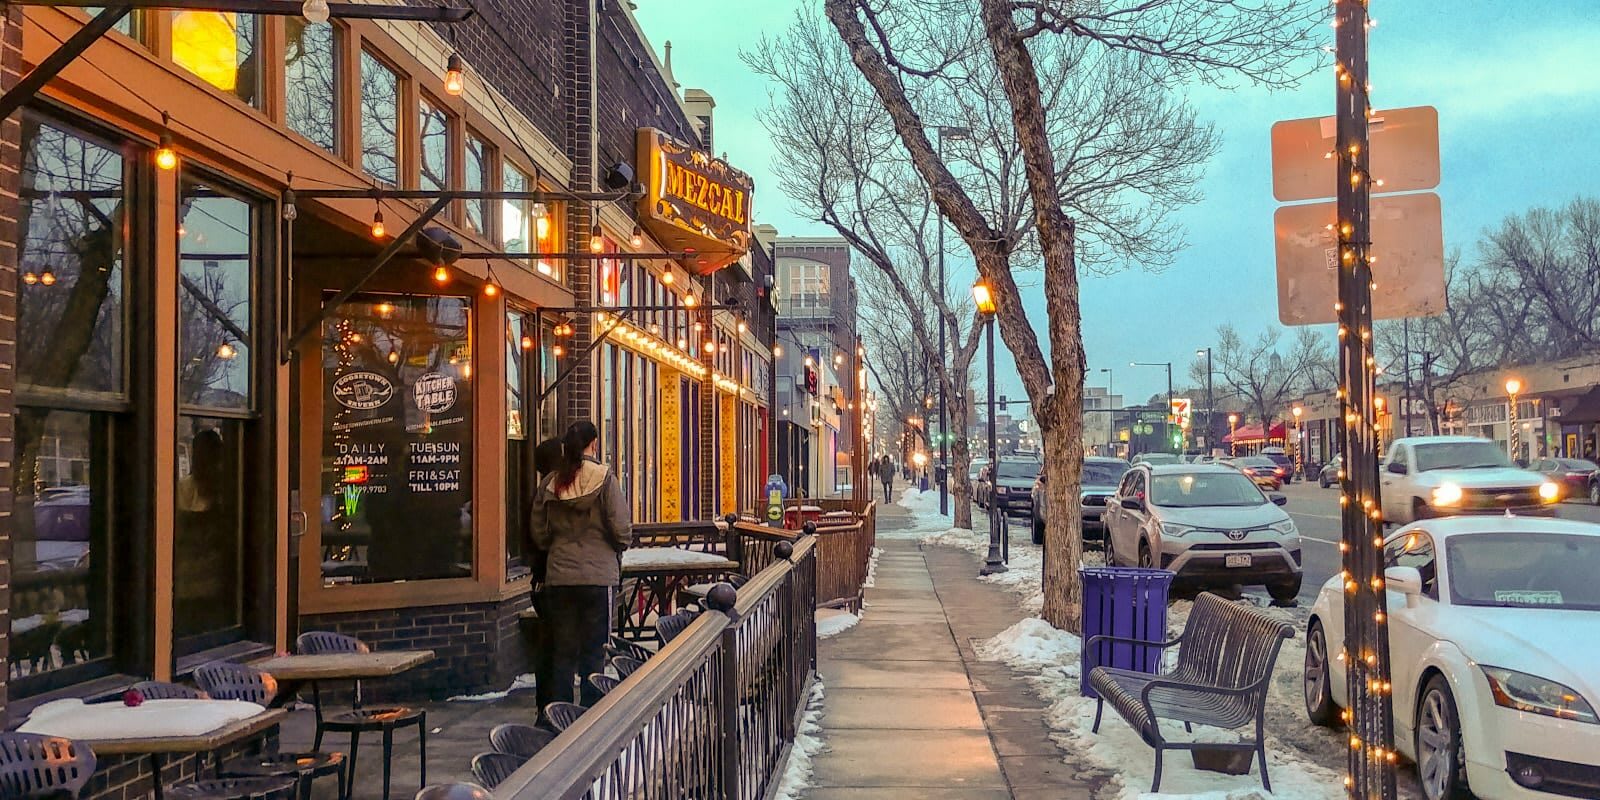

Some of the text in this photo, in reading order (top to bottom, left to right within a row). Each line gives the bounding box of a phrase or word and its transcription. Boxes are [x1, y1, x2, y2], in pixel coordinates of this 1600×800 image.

[667, 160, 745, 225] MEZCAL
[338, 373, 389, 386] GOOSETOWN
[415, 376, 454, 395] KITCHEN
[347, 399, 381, 408] TAVERN
[415, 390, 454, 410] TABLE
[340, 443, 385, 454] DAILY
[410, 442, 460, 453] TUESUN
[335, 455, 388, 465] 11AM-2AM
[411, 454, 460, 464] 11AM-9PM
[409, 470, 460, 480] FRI&SAT
[409, 482, 459, 492] 'TILL 10PM
